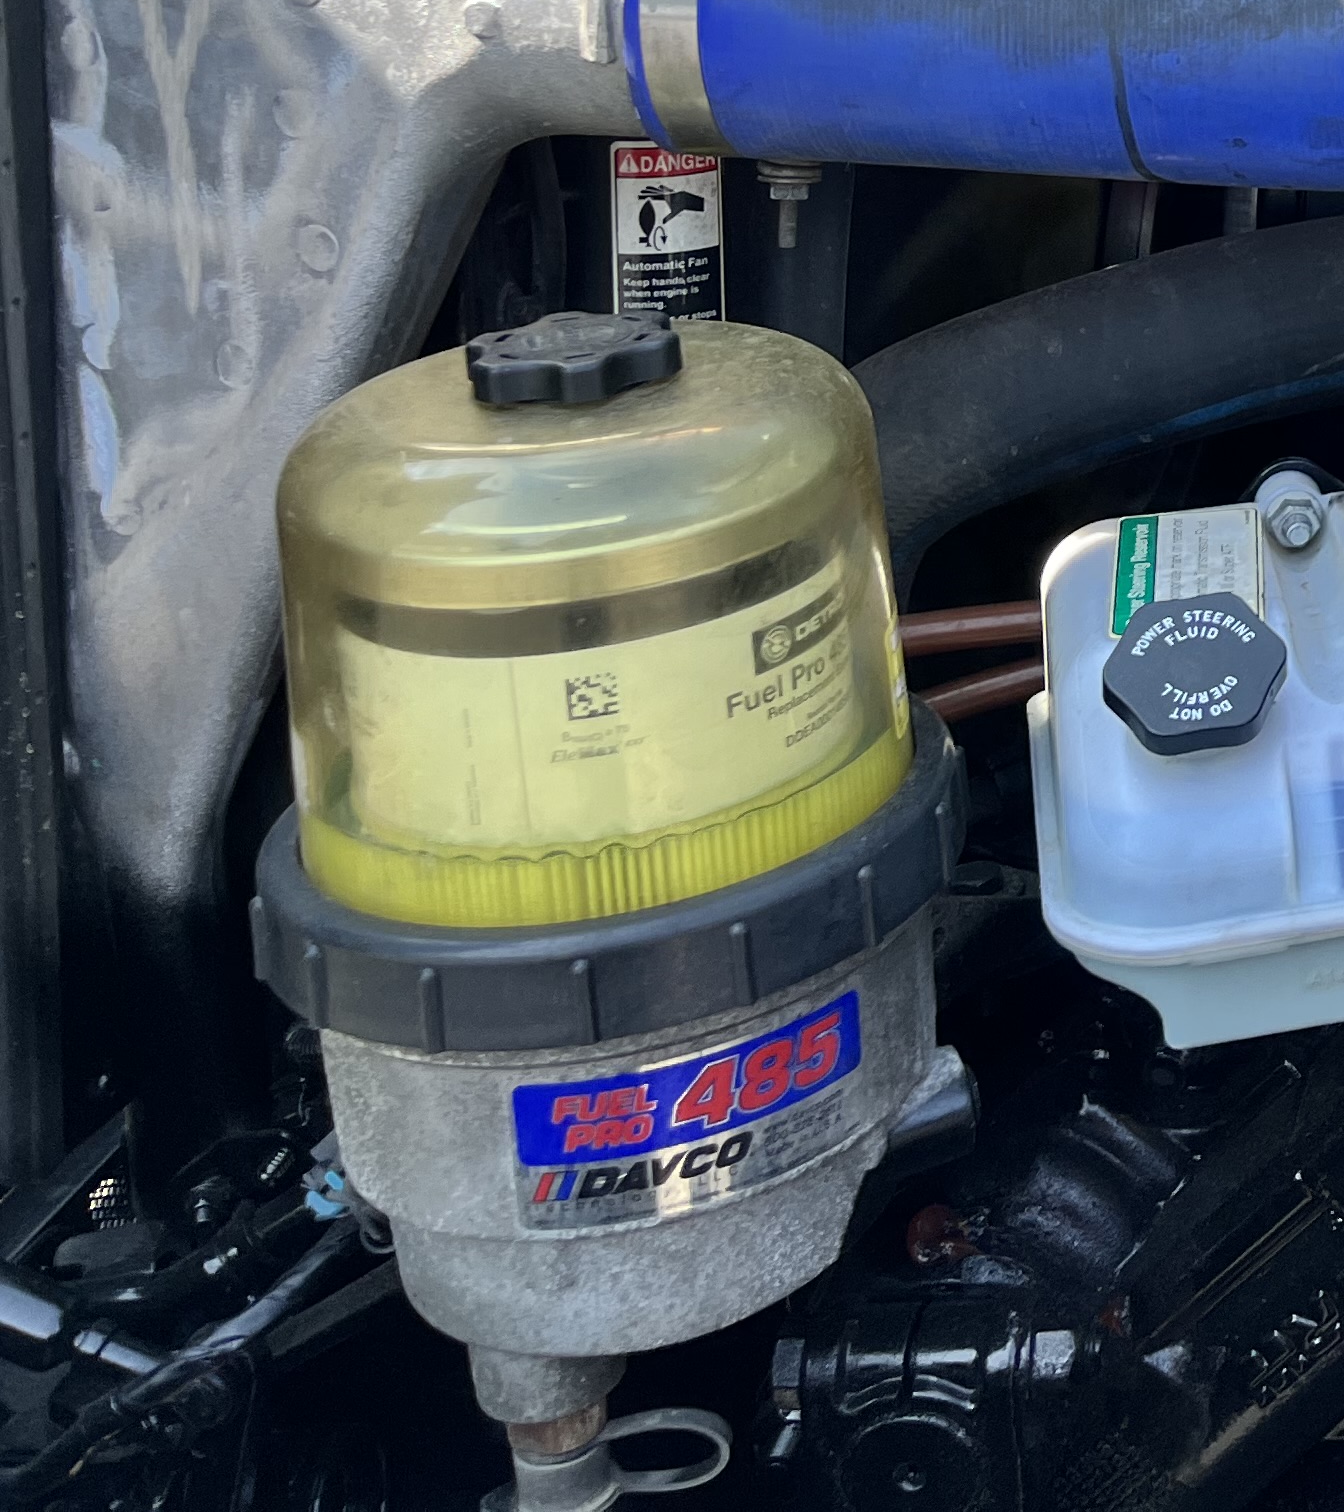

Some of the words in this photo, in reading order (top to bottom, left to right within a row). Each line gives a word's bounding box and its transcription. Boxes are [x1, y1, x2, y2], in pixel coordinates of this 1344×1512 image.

[623, 260, 685, 271] Automatic
[688, 257, 708, 268] Fan
[623, 278, 649, 287] Keep
[652, 276, 685, 286] hands
[687, 273, 710, 283] clear
[653, 289, 687, 298] engine
[691, 285, 699, 294] is
[623, 301, 667, 310] running.
[692, 309, 716, 320] stops
[1130, 523, 1150, 563] Reservoir
[1127, 563, 1151, 599] Steering
[1131, 616, 1175, 656] POWER
[1183, 609, 1256, 644] STEERING
[1164, 625, 1219, 647] FLUID
[726, 674, 783, 718] Fuel
[792, 656, 825, 690] Pro
[1161, 675, 1238, 705] OVERFILL
[1169, 704, 1203, 721] NOT
[1210, 699, 1233, 717] DO
[671, 1011, 841, 1129] 485
[551, 1083, 659, 1125] FUEL
[563, 1115, 654, 1154] PRO
[578, 1130, 753, 1198] DAVCO
